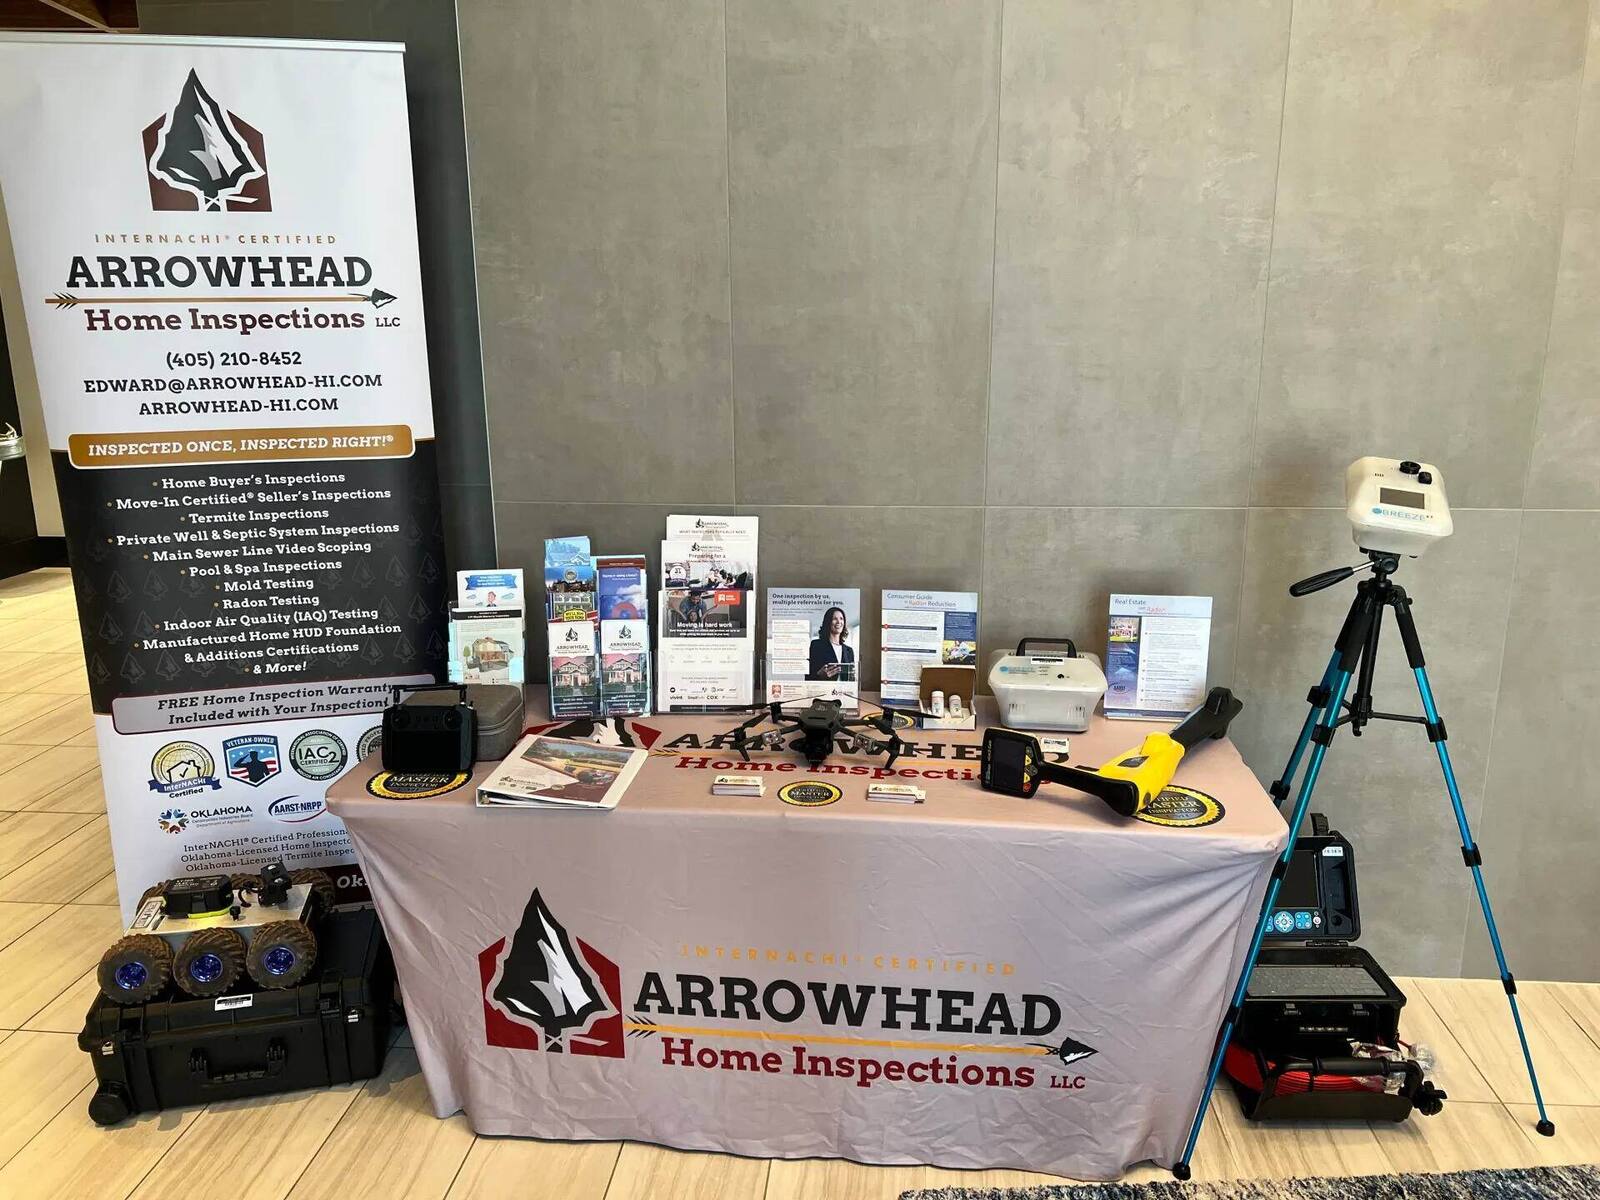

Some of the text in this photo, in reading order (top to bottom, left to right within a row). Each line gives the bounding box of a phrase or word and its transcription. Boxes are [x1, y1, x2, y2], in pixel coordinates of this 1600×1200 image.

[238, 233, 337, 244] CERTIFIED
[66, 255, 372, 288] ARROWHEAD
[84, 308, 401, 336] Home Inspections LLC
[166, 351, 302, 369] (405) 210-8452
[84, 374, 382, 396] EDWARD@ARROWHEAD-HI.COM
[138, 398, 339, 416] ARROWHEAD-HI.COM
[88, 442, 183, 457] INSPECTED
[186, 439, 237, 455] ONCE,
[240, 437, 328, 452] INSPECTED
[162, 472, 346, 489] Home Buyer's Inspections
[117, 498, 179, 510] Move-In
[257, 490, 309, 503] Seller's
[312, 488, 392, 503] Inspections
[189, 508, 329, 525] Termite Inspections
[117, 523, 400, 546] Private Well & Septic System Inspections
[153, 541, 372, 562] Main Sewer Line Video Scoping
[189, 559, 342, 577] Pool & Spa Inspections
[224, 578, 314, 593] Mold Testing
[222, 595, 319, 610] Radon Testing
[927, 600, 957, 608] Reduction
[164, 608, 379, 631] Indoor Air Quality (IAQ) Testing
[143, 623, 402, 650] Manufactured Home HUD Foundation
[184, 642, 359, 663] & Additions Certifications
[253, 662, 307, 674] & More!
[157, 683, 394, 710] FREE Home Inspection Warranty
[168, 699, 390, 725] Included with Your Inspection!
[675, 756, 796, 772] Home
[164, 779, 207, 792] InterNACHI
[169, 787, 204, 798] Certified
[190, 805, 253, 818] OKLAHOMA
[274, 801, 322, 814] AARST-NRPP
[251, 833, 294, 845] Certified
[296, 829, 349, 842] Profession
[181, 838, 351, 863] Oklahoma-Licensed Home Inspecto
[186, 848, 354, 873] Oklahoma-Licensed Termite Inspec
[337, 875, 368, 889] Ok
[873, 955, 1016, 976] CERTIFIED
[634, 971, 1062, 1037] ARROWHEAD
[662, 1037, 1086, 1090] Home Inspections LLC
